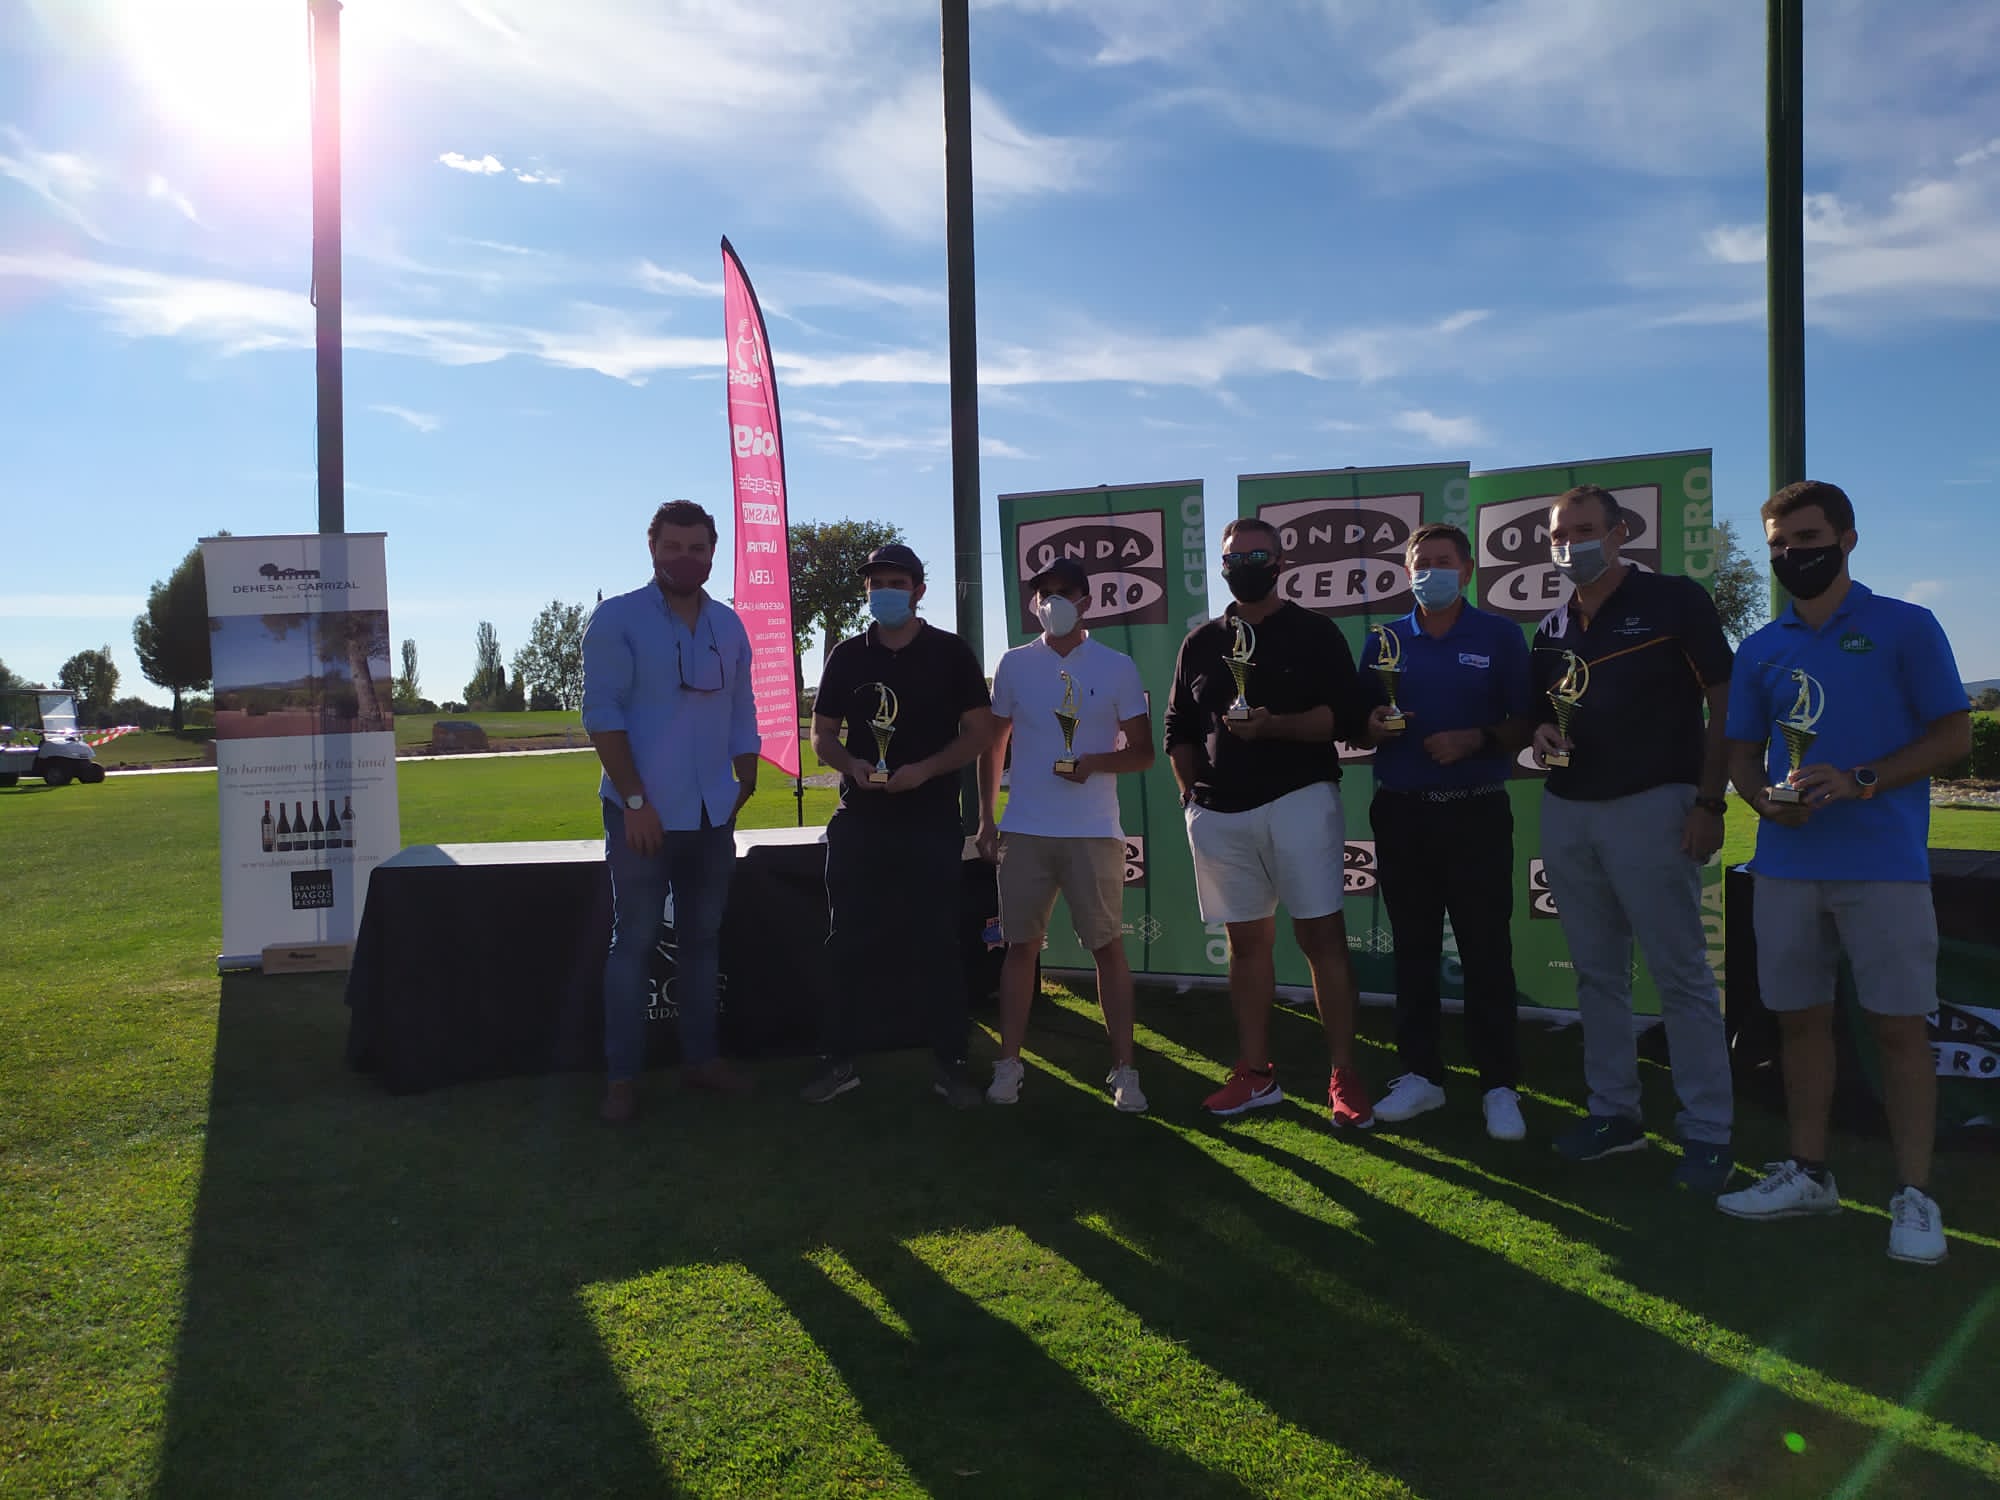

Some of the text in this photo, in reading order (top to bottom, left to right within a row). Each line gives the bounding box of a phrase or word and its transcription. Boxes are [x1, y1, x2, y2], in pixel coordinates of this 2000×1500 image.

[1683, 467, 1717, 578] CERO
[1181, 495, 1206, 597] CERO
[1280, 522, 1396, 551] ONDA
[1038, 537, 1142, 564] ONDA
[232, 581, 361, 594] DEHESA CARRIZAL
[1101, 582, 1144, 608] RO
[1285, 568, 1396, 599] CERO
[1509, 571, 1561, 601] CE
[240, 763, 298, 776] harmony
[294, 890, 332, 900] PAGOS
[1931, 1047, 1997, 1074] ERO
